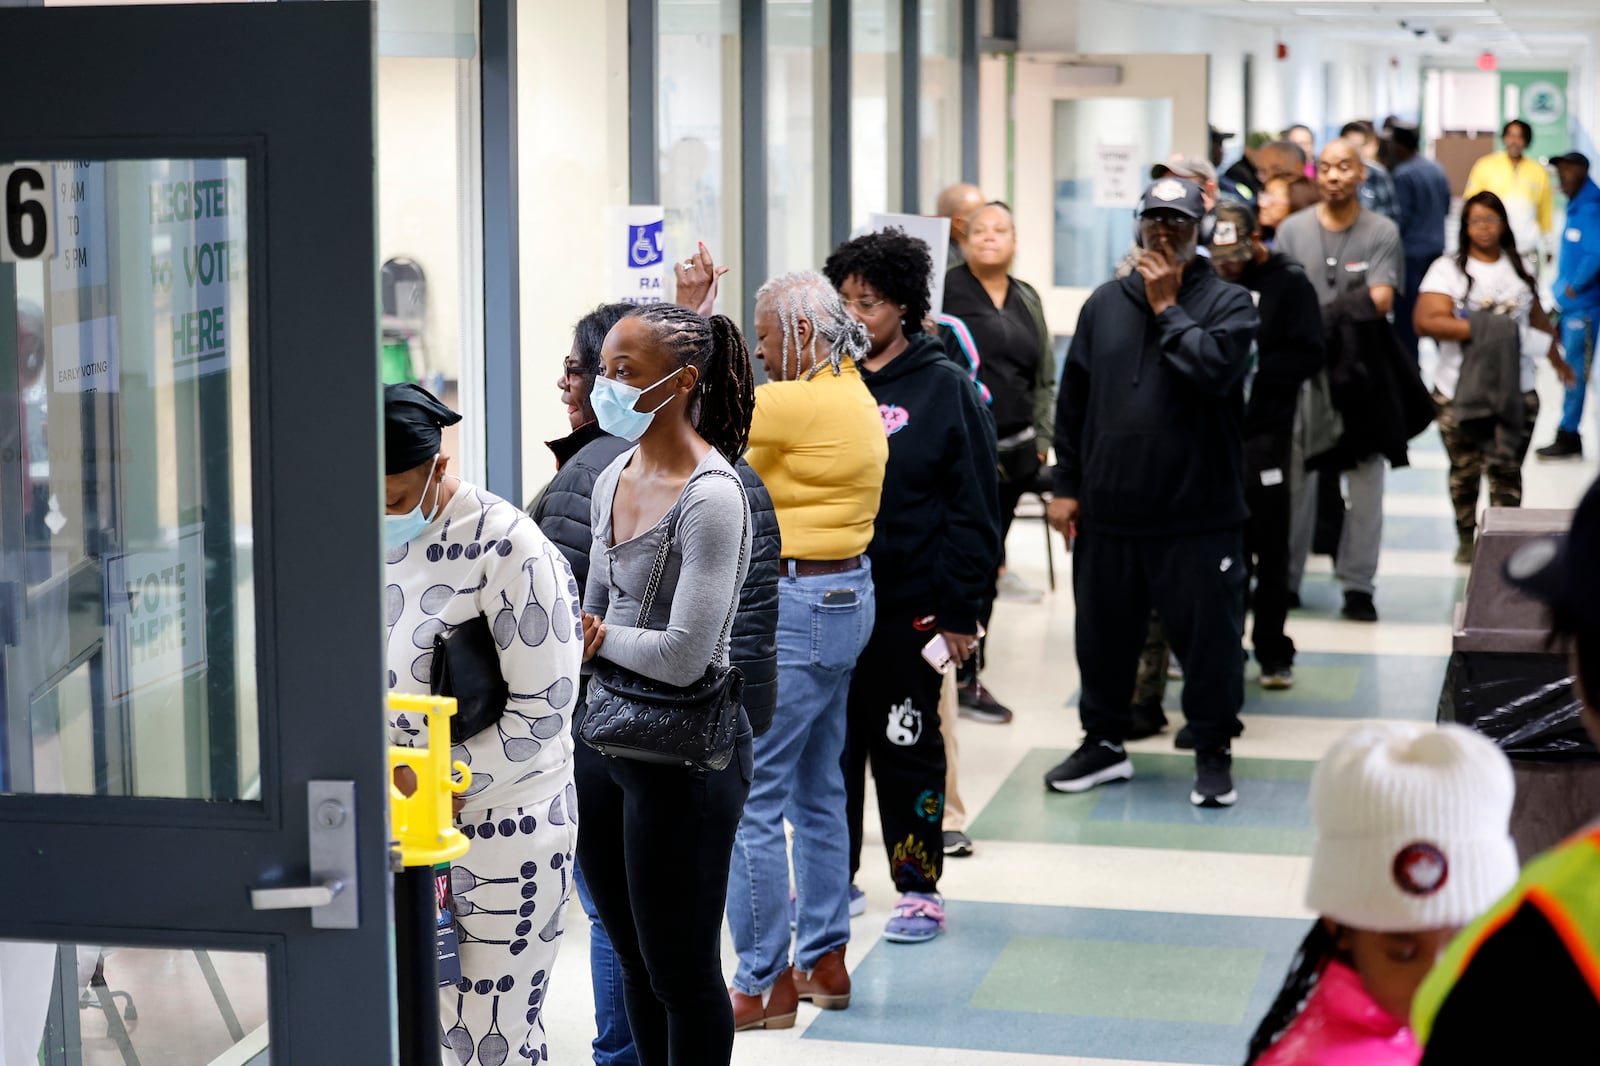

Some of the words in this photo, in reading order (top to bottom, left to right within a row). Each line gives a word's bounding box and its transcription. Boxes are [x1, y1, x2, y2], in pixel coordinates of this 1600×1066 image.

[6, 167, 47, 260] 6
[61, 182, 66, 203] 9
[70, 180, 85, 202] AM
[67, 215, 80, 237] TO
[64, 248, 71, 270] 5
[73, 246, 87, 269] PM
[182, 239, 240, 289] VOTE
[171, 306, 225, 356] HERE
[58, 367, 80, 384] EARLY
[80, 360, 108, 377] VOTING
[126, 562, 186, 619] VOTE
[129, 607, 187, 667] HERE
